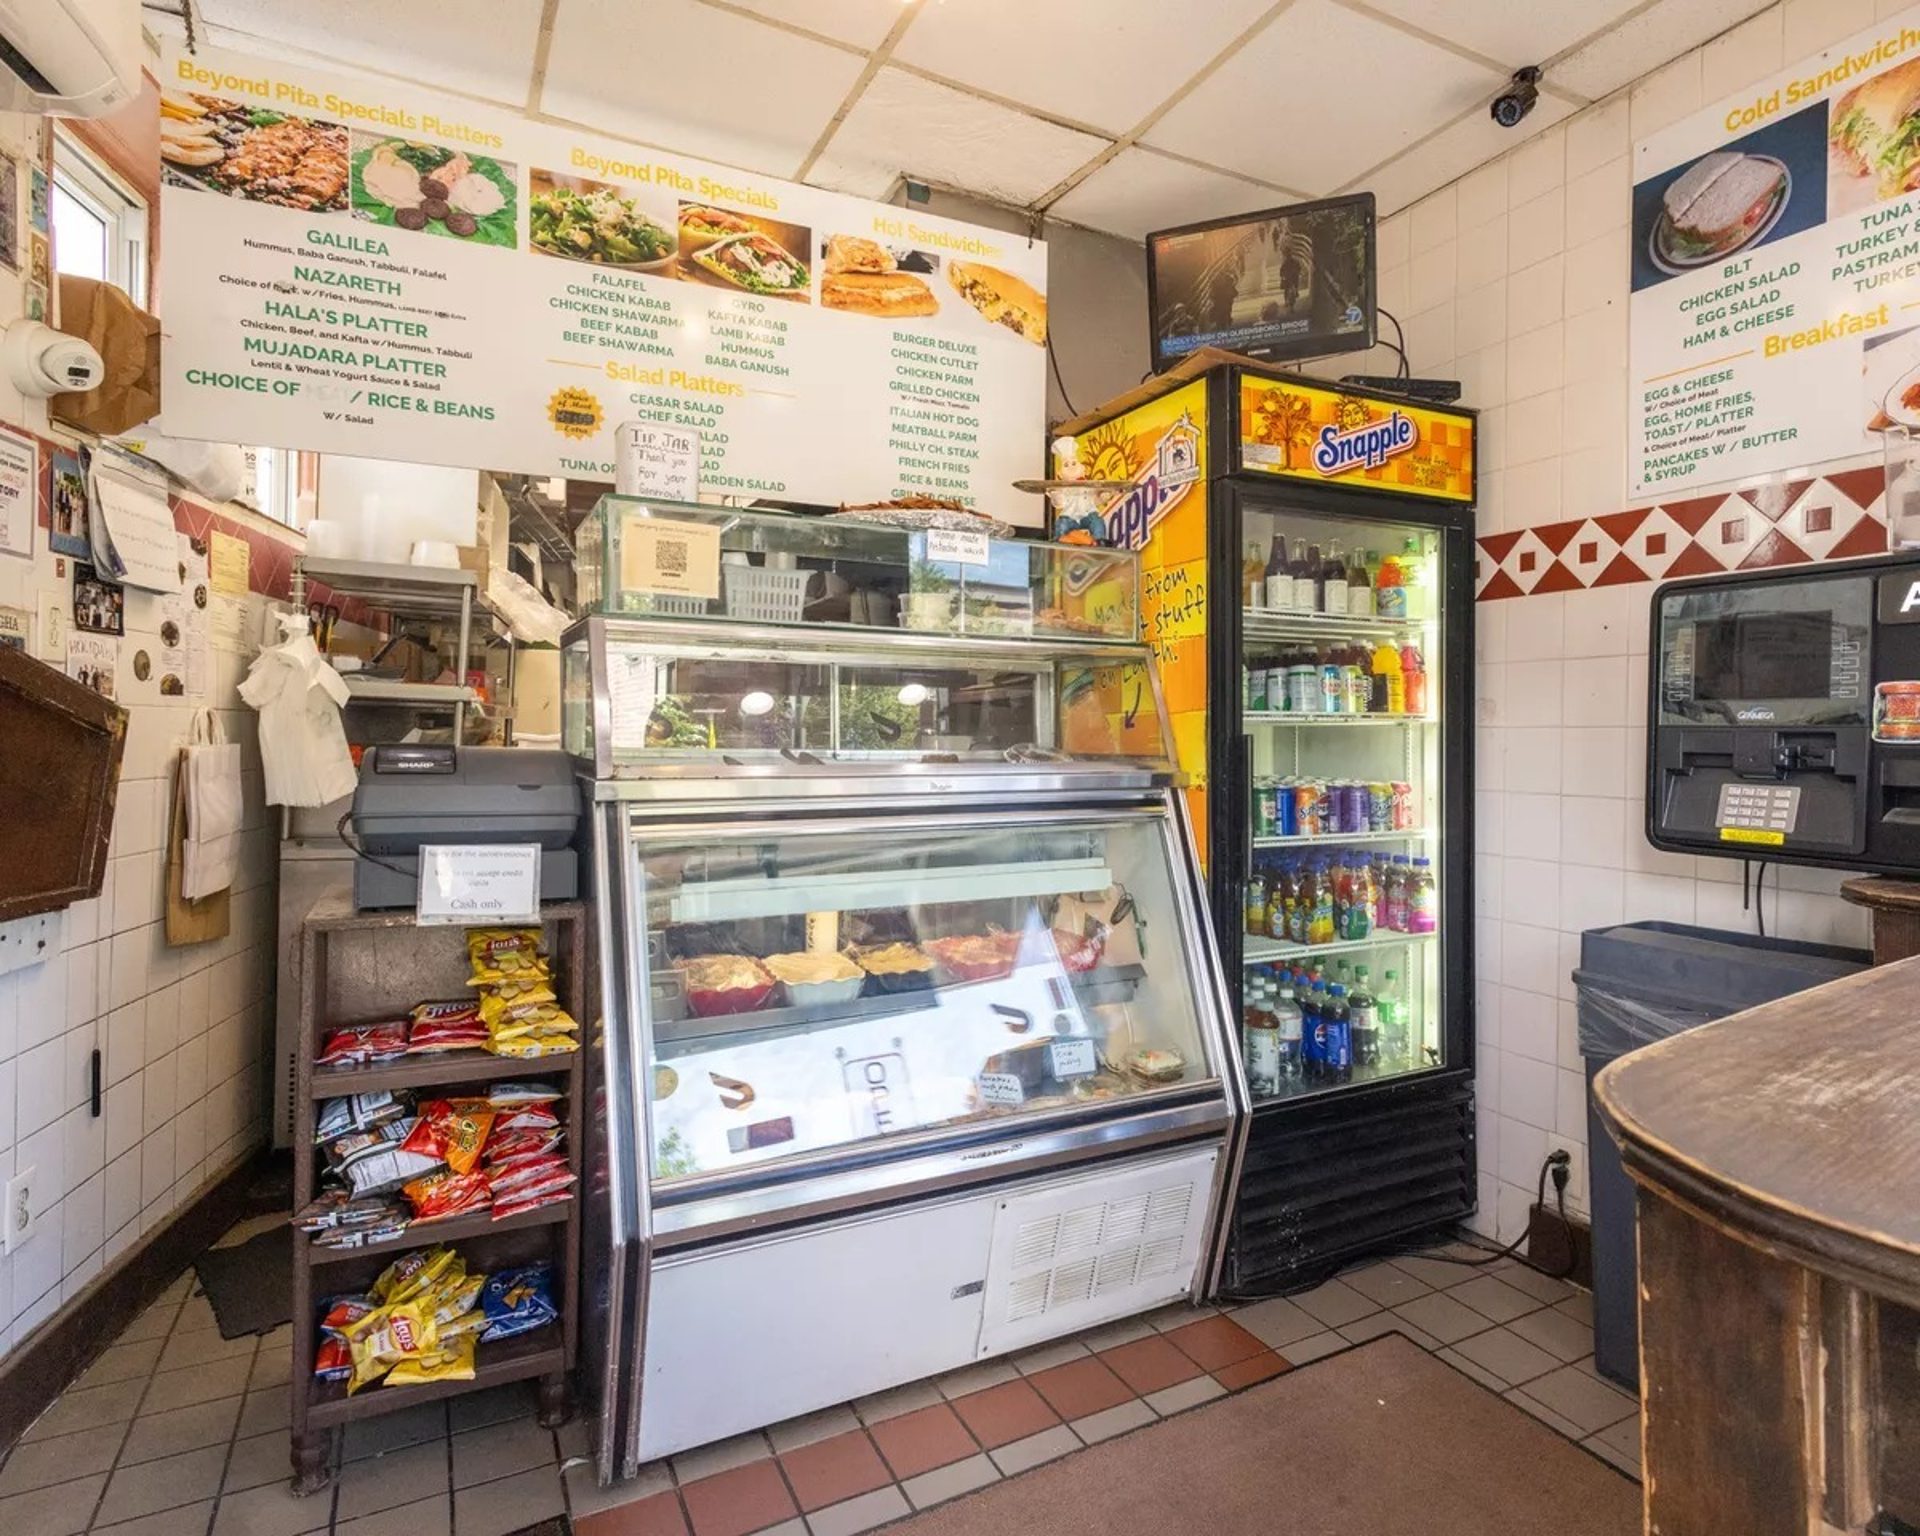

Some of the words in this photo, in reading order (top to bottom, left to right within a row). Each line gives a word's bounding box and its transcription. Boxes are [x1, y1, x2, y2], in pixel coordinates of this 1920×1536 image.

[1724, 90, 1779, 131] Cold
[1785, 28, 1920, 105] Sandwich
[178, 60, 270, 97] Beyond
[277, 84, 319, 108] Pita
[325, 94, 417, 129] Specials
[422, 114, 502, 148] Platters
[571, 148, 651, 182] Beyond
[656, 166, 694, 192] Pita
[699, 176, 778, 211] Specials
[873, 218, 903, 236] Hot
[1861, 202, 1912, 230] TUNA
[307, 229, 389, 256] GALILEA
[1836, 224, 1908, 259] TURKEY
[298, 247, 324, 261] Baba
[413, 267, 447, 280] Falafel
[1723, 259, 1752, 278] BLT
[1832, 242, 1920, 280] PASTRAM
[219, 274, 256, 288] Choice
[259, 281, 271, 289] of
[294, 266, 401, 296] NAZARETH
[593, 274, 646, 292] FALAFEL
[1679, 280, 1745, 312] CHICKEN
[1749, 262, 1801, 288] SALAD
[567, 285, 625, 304] CHICKEN
[628, 296, 671, 311] KABAB
[732, 299, 765, 313] GYRO
[1696, 307, 1727, 326] EGG
[1730, 289, 1781, 315] SALAD
[265, 301, 338, 325] HALA'S
[343, 313, 428, 338] PLATTER
[549, 297, 609, 317] CHICKEN
[612, 308, 686, 328] SHAWARMA
[708, 310, 746, 325] KAFTA
[748, 316, 788, 332] KABAB
[580, 318, 612, 332] BEEF
[616, 324, 658, 340] KABAB
[710, 326, 743, 339] LAMB
[746, 331, 785, 347] KABAB
[1683, 329, 1716, 349] HAM
[1720, 325, 1730, 337] &
[1734, 304, 1795, 332] CHEESE
[1764, 304, 1888, 358] Breakfast
[319, 330, 338, 341] and
[341, 334, 369, 346] Kafta
[436, 348, 472, 359] Tabbuli
[563, 331, 595, 345] BEEF
[599, 337, 674, 357] SHAWARMA
[721, 342, 775, 360] HUMMUS
[893, 332, 936, 348] BURGER
[938, 339, 977, 355] DELUXE
[244, 337, 357, 366] MUJADARA
[362, 354, 446, 378] PLATTER
[705, 355, 738, 369] BABA
[741, 361, 789, 376] GANUSH
[891, 348, 938, 365] CHICKEN
[940, 356, 979, 371] CUTLET
[251, 358, 281, 371] Lentil
[284, 363, 292, 372] &
[295, 364, 330, 378] Wheat
[332, 369, 368, 382] Yogurt
[370, 375, 400, 387] Sauce
[402, 379, 410, 387] &
[412, 380, 441, 391] Salad
[606, 361, 665, 387] Salad
[669, 370, 745, 398] Platters
[896, 365, 942, 382] CHICKEN
[945, 374, 973, 386] PARM
[1644, 385, 1670, 402] EGG
[1672, 384, 1680, 395] &
[1684, 369, 1734, 392] CHEESE
[186, 369, 269, 393] CHOICE
[273, 380, 301, 397] OF
[350, 390, 362, 404] /
[368, 393, 411, 411] RICE
[416, 399, 428, 412] &
[434, 401, 495, 420] BEANS
[889, 381, 933, 396] GRILLED
[935, 387, 980, 403] CHICKEN
[1660, 396, 1687, 410] Choice
[1688, 393, 1696, 402] of
[1698, 388, 1718, 399] Meat
[630, 393, 680, 409] CEASAR
[684, 399, 724, 415] SALAD
[1675, 402, 1712, 420] HOME
[345, 414, 374, 425] Salad
[638, 409, 672, 422] CHEF
[675, 414, 716, 428] SALAD
[890, 407, 931, 420] ITALIAN
[933, 412, 954, 423] HOT
[956, 416, 979, 427] DOG
[1696, 406, 1754, 429] PLATTER
[661, 433, 690, 452] JAR
[892, 423, 946, 440] MEATBALL
[948, 431, 977, 442] PARM
[1319, 413, 1409, 468] Snapple
[1651, 438, 1677, 452] Choice
[1679, 436, 1687, 445] of
[638, 449, 665, 464] Thank
[671, 457, 687, 470] you
[700, 446, 725, 457] LAD
[889, 440, 925, 452] PHILLY
[947, 447, 980, 459] STEAK
[1644, 445, 1709, 471] PANCAKES
[1712, 443, 1725, 455] W
[1742, 427, 1798, 449] BUTTER
[559, 457, 597, 472] TUNA
[699, 474, 744, 489] ARDEN
[746, 480, 785, 492] SALAD
[899, 457, 940, 470] FRENCH
[942, 462, 970, 474] FRIES
[1644, 472, 1652, 482] &
[1655, 463, 1696, 481] SYRUP
[665, 473, 687, 485] your
[899, 473, 923, 484] RICE
[925, 477, 932, 485] &
[935, 478, 969, 489] BEANS
[1145, 568, 1188, 600] from
[1155, 583, 1205, 634] stuff
[450, 899, 477, 909] Cash
[480, 899, 502, 910] only
